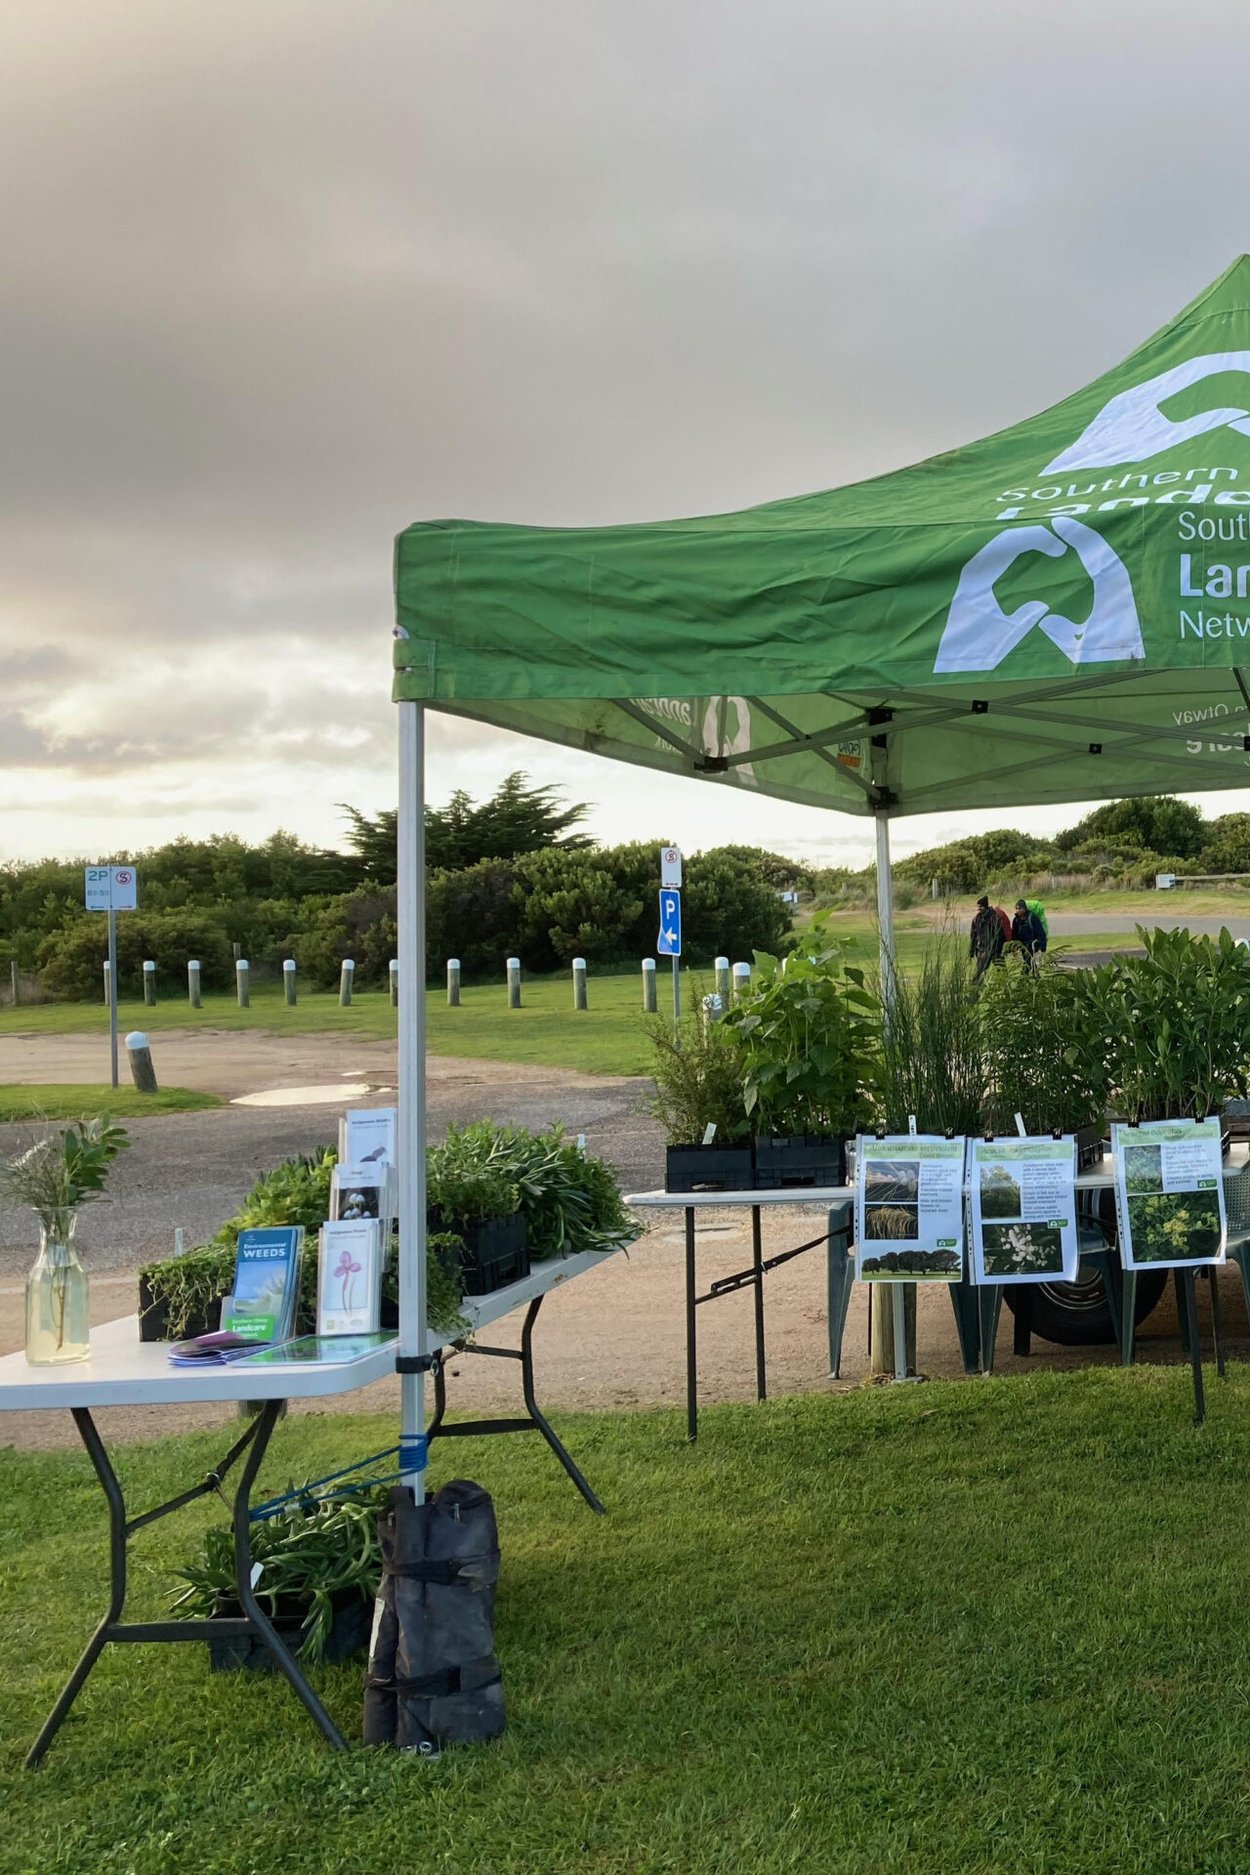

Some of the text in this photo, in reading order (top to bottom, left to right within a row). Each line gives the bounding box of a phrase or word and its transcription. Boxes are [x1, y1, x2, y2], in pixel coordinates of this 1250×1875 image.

[995, 467, 1239, 502] Southern
[88, 870, 108, 881] 2P
[666, 900, 676, 920] P
[243, 1248, 286, 1258] WEEDS
[233, 1324, 266, 1332] Landcare
